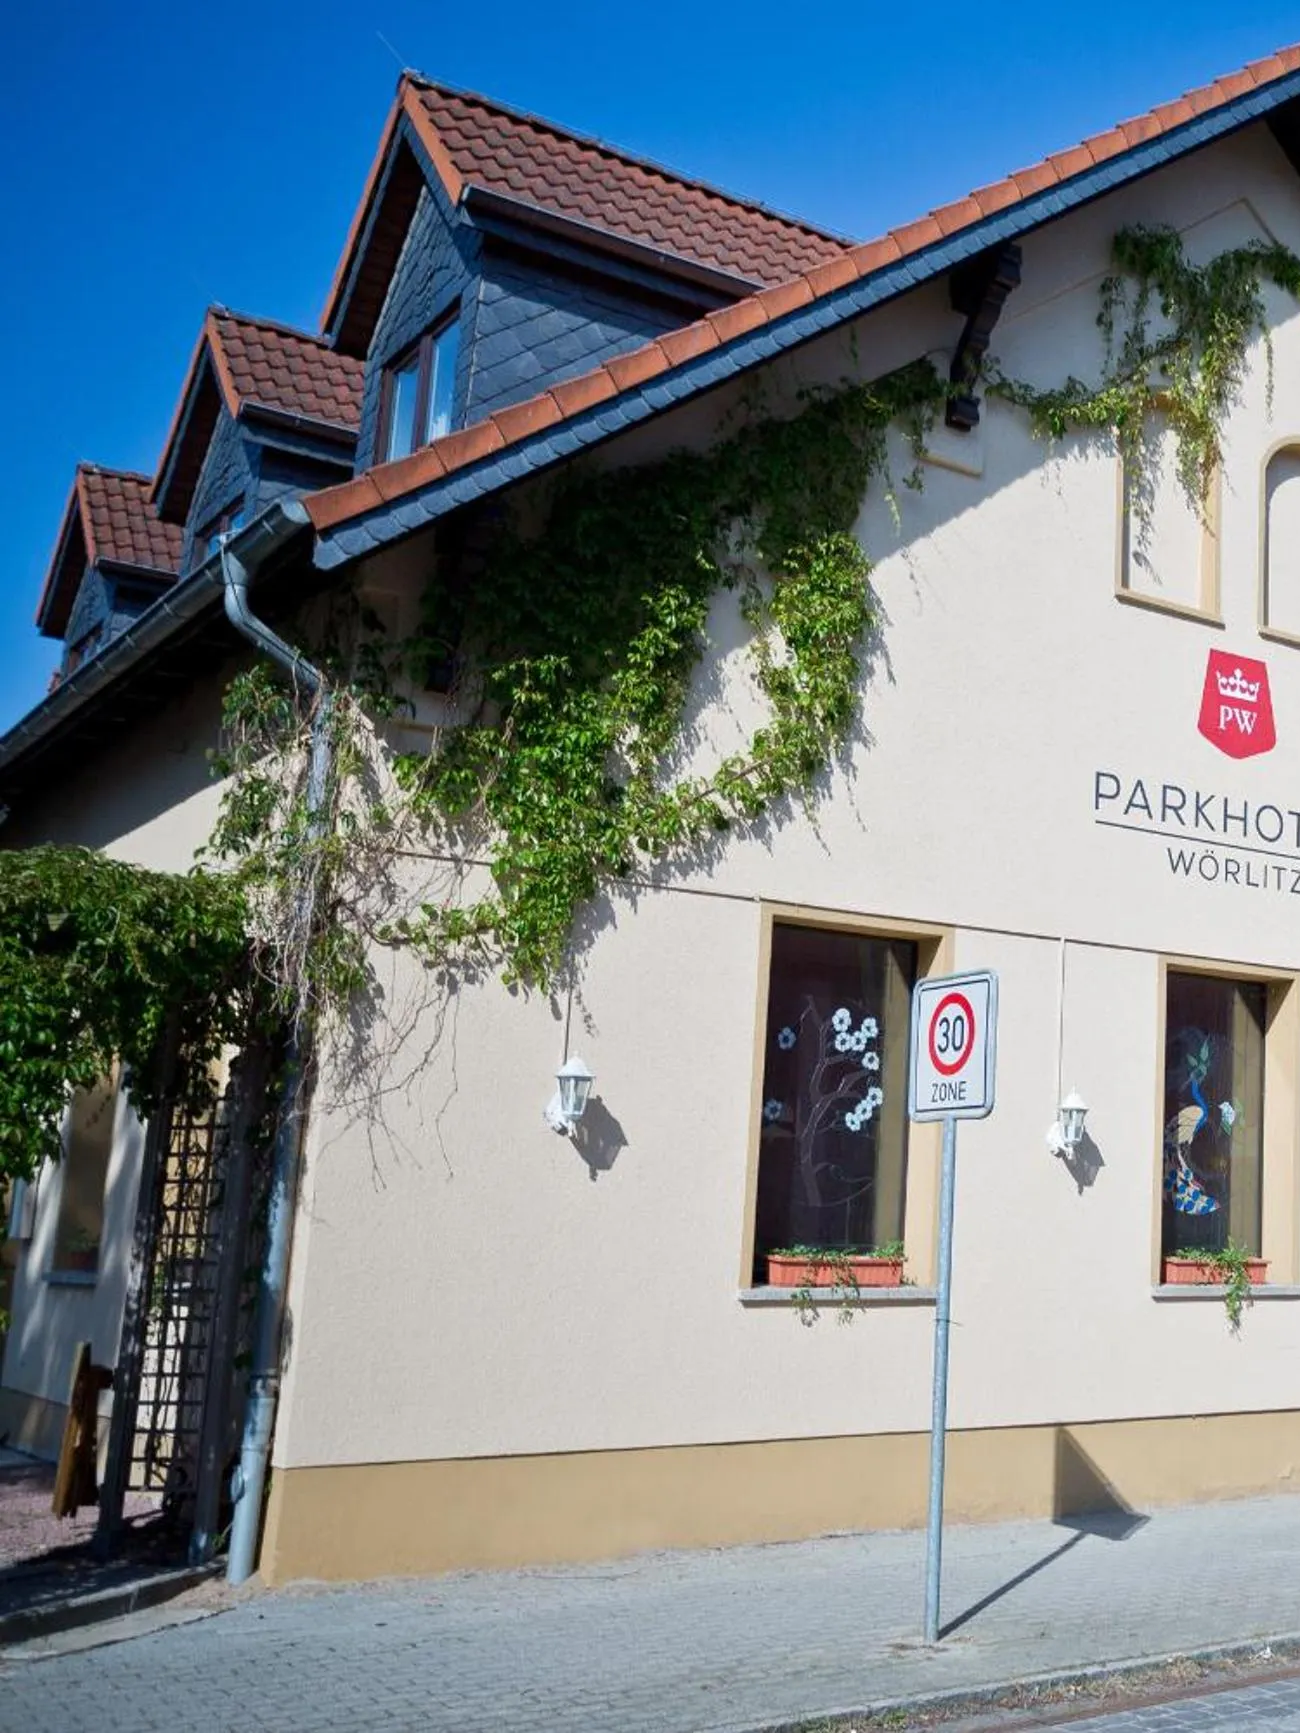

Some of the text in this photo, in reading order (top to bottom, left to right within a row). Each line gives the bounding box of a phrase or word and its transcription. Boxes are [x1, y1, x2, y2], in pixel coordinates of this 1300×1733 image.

[1219, 704, 1258, 735] PW
[937, 1015, 965, 1054] 30
[931, 1081, 967, 1103] ZONE
